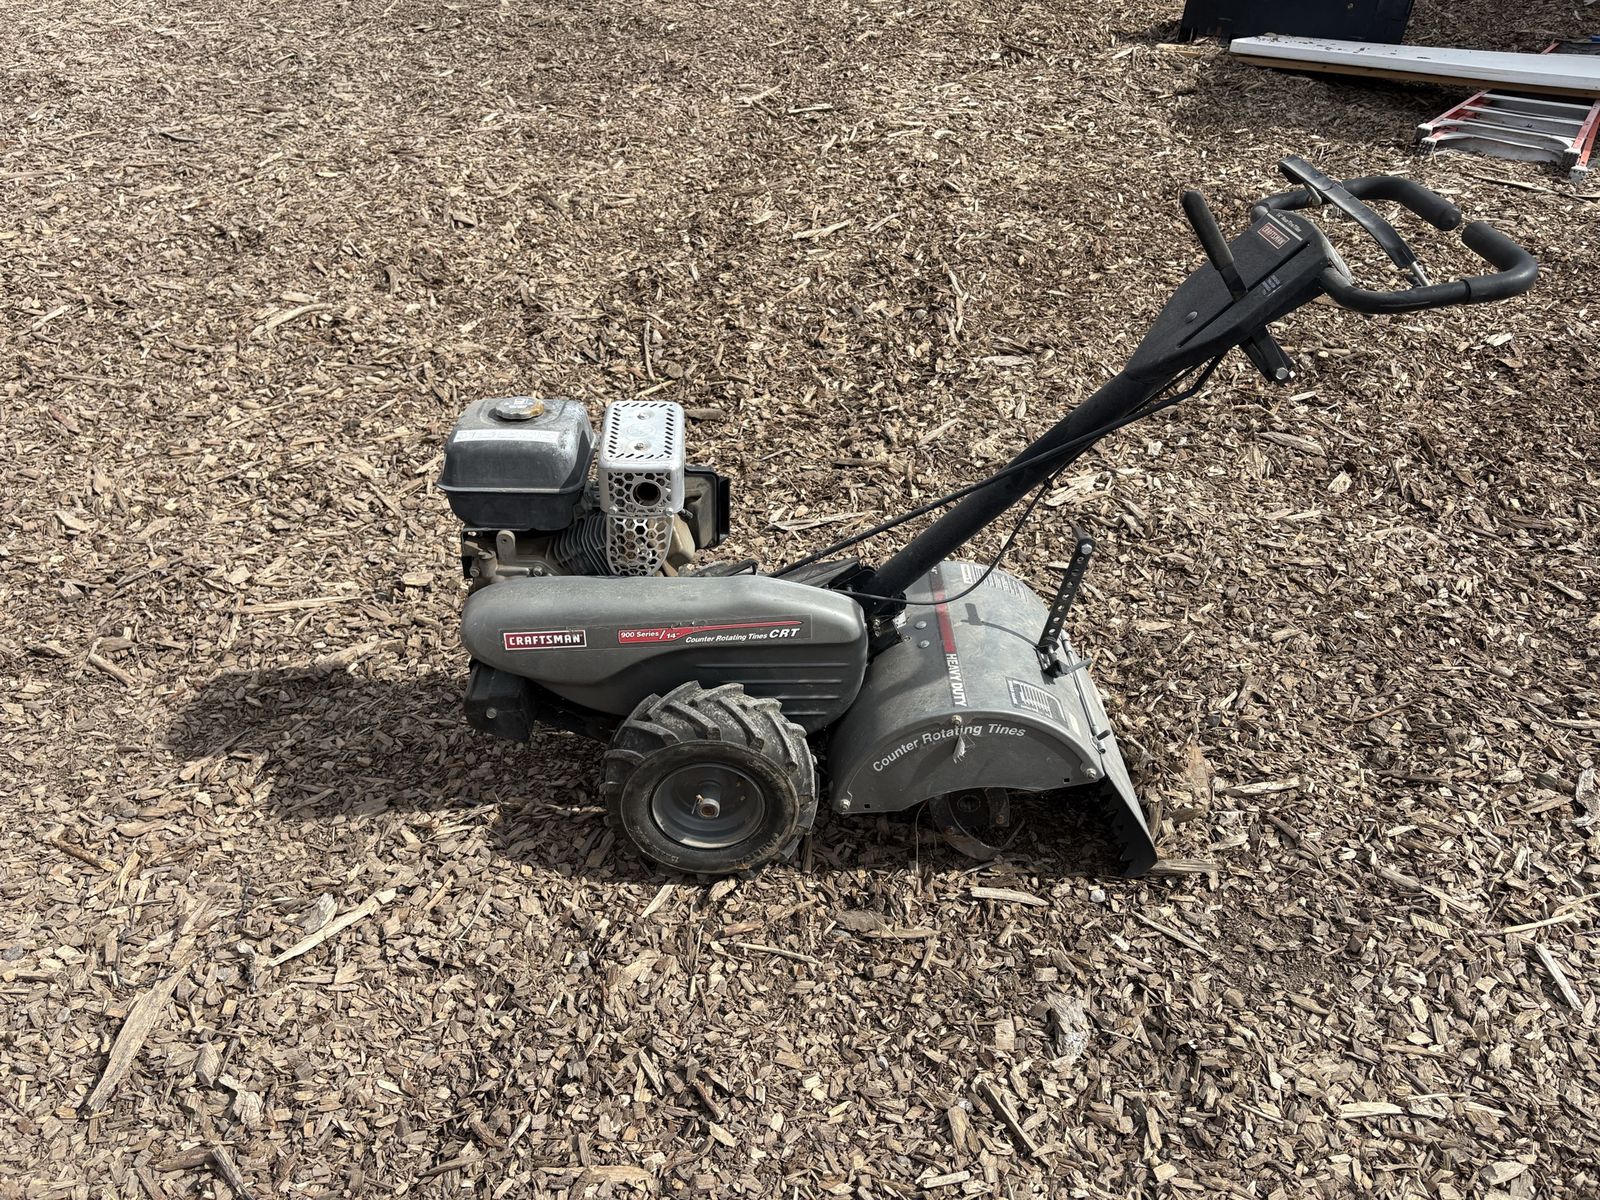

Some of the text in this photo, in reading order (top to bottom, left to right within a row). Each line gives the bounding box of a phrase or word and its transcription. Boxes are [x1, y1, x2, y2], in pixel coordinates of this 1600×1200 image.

[509, 634, 582, 646] CRAFTSMAN
[621, 631, 635, 639] 900
[685, 636, 714, 644] Counter
[715, 633, 746, 643] Rotating
[769, 628, 800, 639] CRT
[945, 653, 967, 707] HEAVY DUTY
[872, 723, 1026, 772] Counter Rotating Tines
